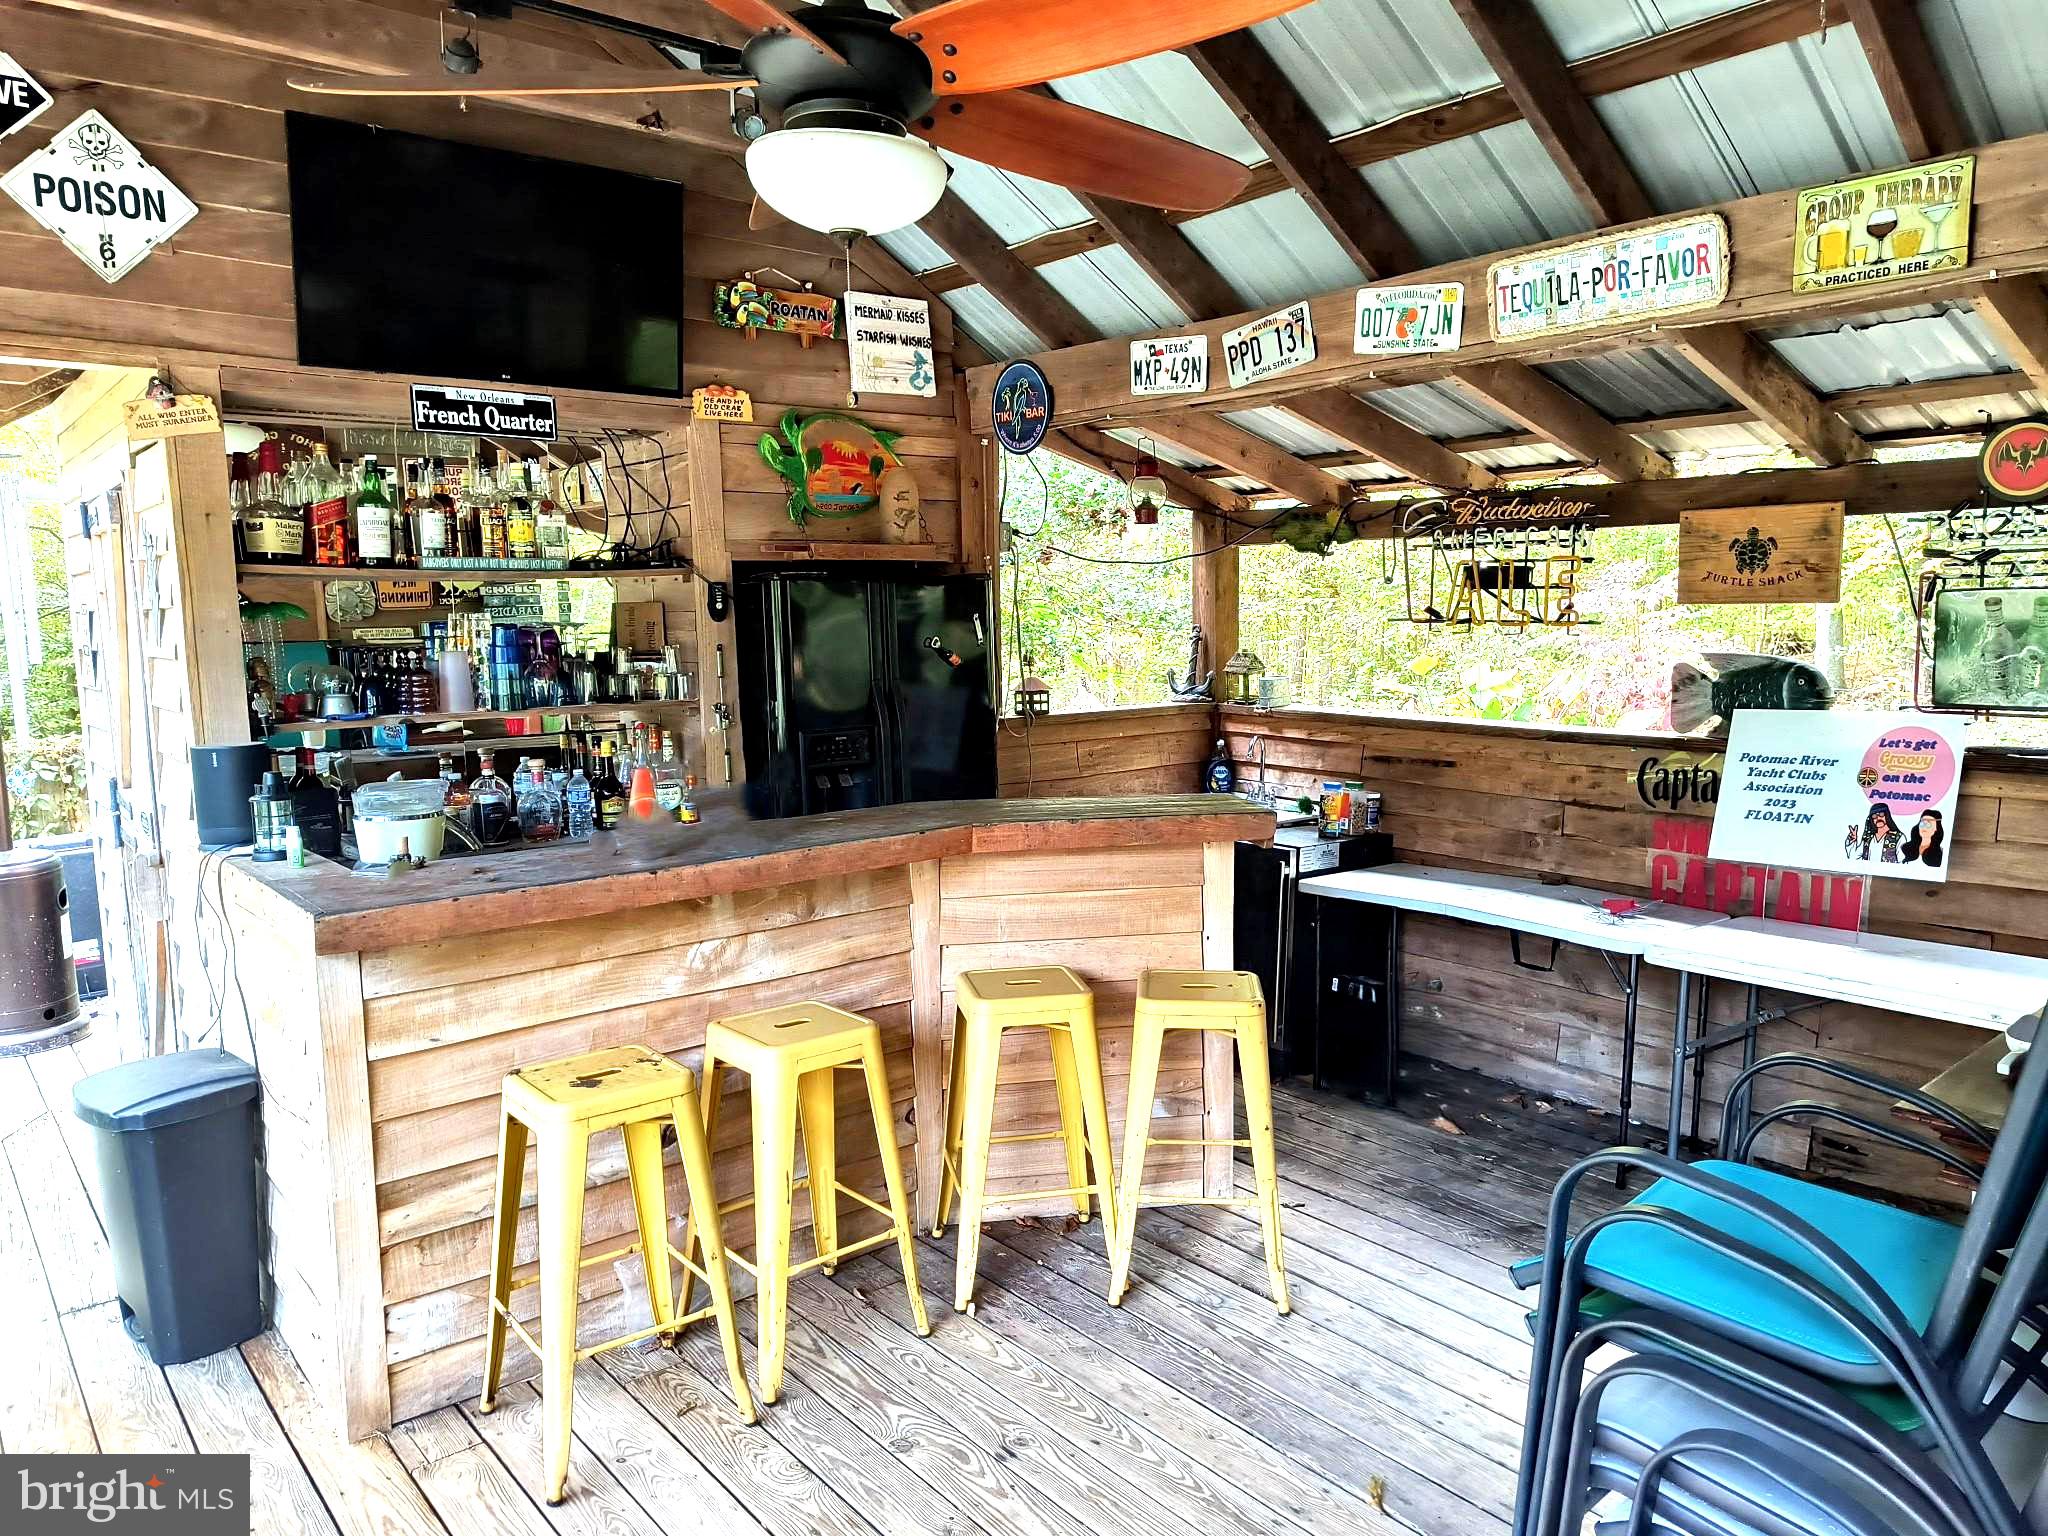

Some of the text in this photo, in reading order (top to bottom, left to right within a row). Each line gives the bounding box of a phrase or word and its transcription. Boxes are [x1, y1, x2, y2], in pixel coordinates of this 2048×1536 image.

[32, 172, 167, 223] POISON
[1805, 175, 1963, 237] GROUP THERAPY
[99, 240, 116, 262] 6
[1825, 260, 1929, 286] PRACTICED HERE
[769, 300, 828, 321] ROATAN
[854, 305, 926, 324] MERMAID KISSES
[1420, 304, 1454, 336] 7JN
[1252, 318, 1278, 333] HAWAII
[856, 330, 933, 349] STARFISH WISHES
[1164, 343, 1189, 354] TEXAS
[1227, 316, 1305, 375] PPD 137
[1377, 338, 1434, 348] SUNSHINE STATE
[1134, 356, 1201, 386] MXP 49N
[1251, 356, 1292, 377] ALOHA STATE
[456, 389, 476, 400] New
[479, 391, 515, 404] Orleans
[135, 415, 214, 430] MUST SURRENDER
[138, 408, 208, 422] ALL WHO ENTER
[416, 400, 553, 432] French Quarter
[996, 406, 1045, 423] TIKI BAR
[1451, 496, 1588, 524] Budweiser
[1433, 523, 1591, 549] AMERICAN
[1701, 570, 1805, 587] TURTLE SHACK
[1446, 555, 1582, 627] ALE
[1879, 738, 1938, 751] Let's get
[1739, 752, 1840, 767] Potomac River
[1880, 750, 1934, 771] Groovy
[1747, 767, 1828, 780] Yacht Clubs
[1882, 773, 1926, 784] on the
[1743, 781, 1824, 795] Association
[1869, 789, 1931, 802] Potomac
[1764, 798, 1797, 809] 2023
[1744, 810, 1815, 824] FLOAT-IN
[1652, 855, 1866, 932] CAPTAIN
